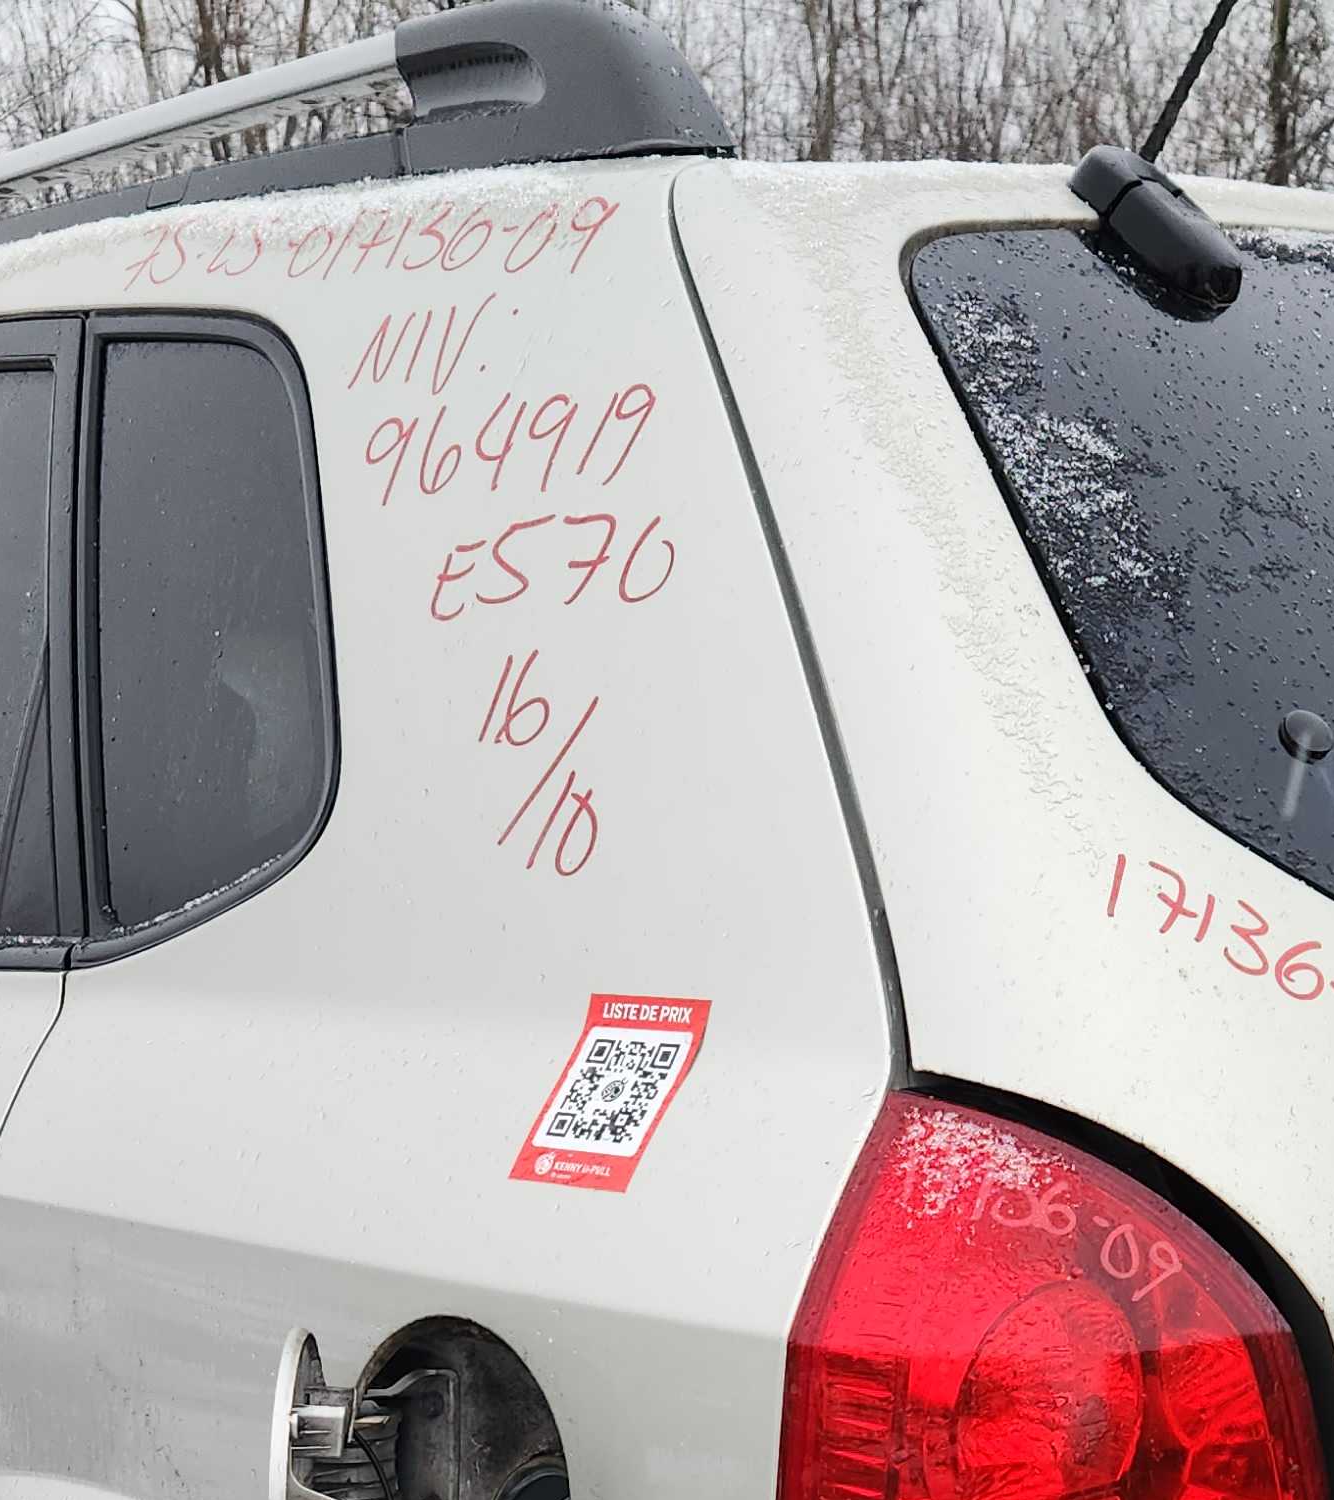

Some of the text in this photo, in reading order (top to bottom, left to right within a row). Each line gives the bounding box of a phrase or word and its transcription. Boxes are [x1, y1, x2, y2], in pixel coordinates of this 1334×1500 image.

[365, 383, 657, 506] 964919
[431, 513, 675, 621] E570
[602, 1001, 693, 1025] LISTE DE PRIX
